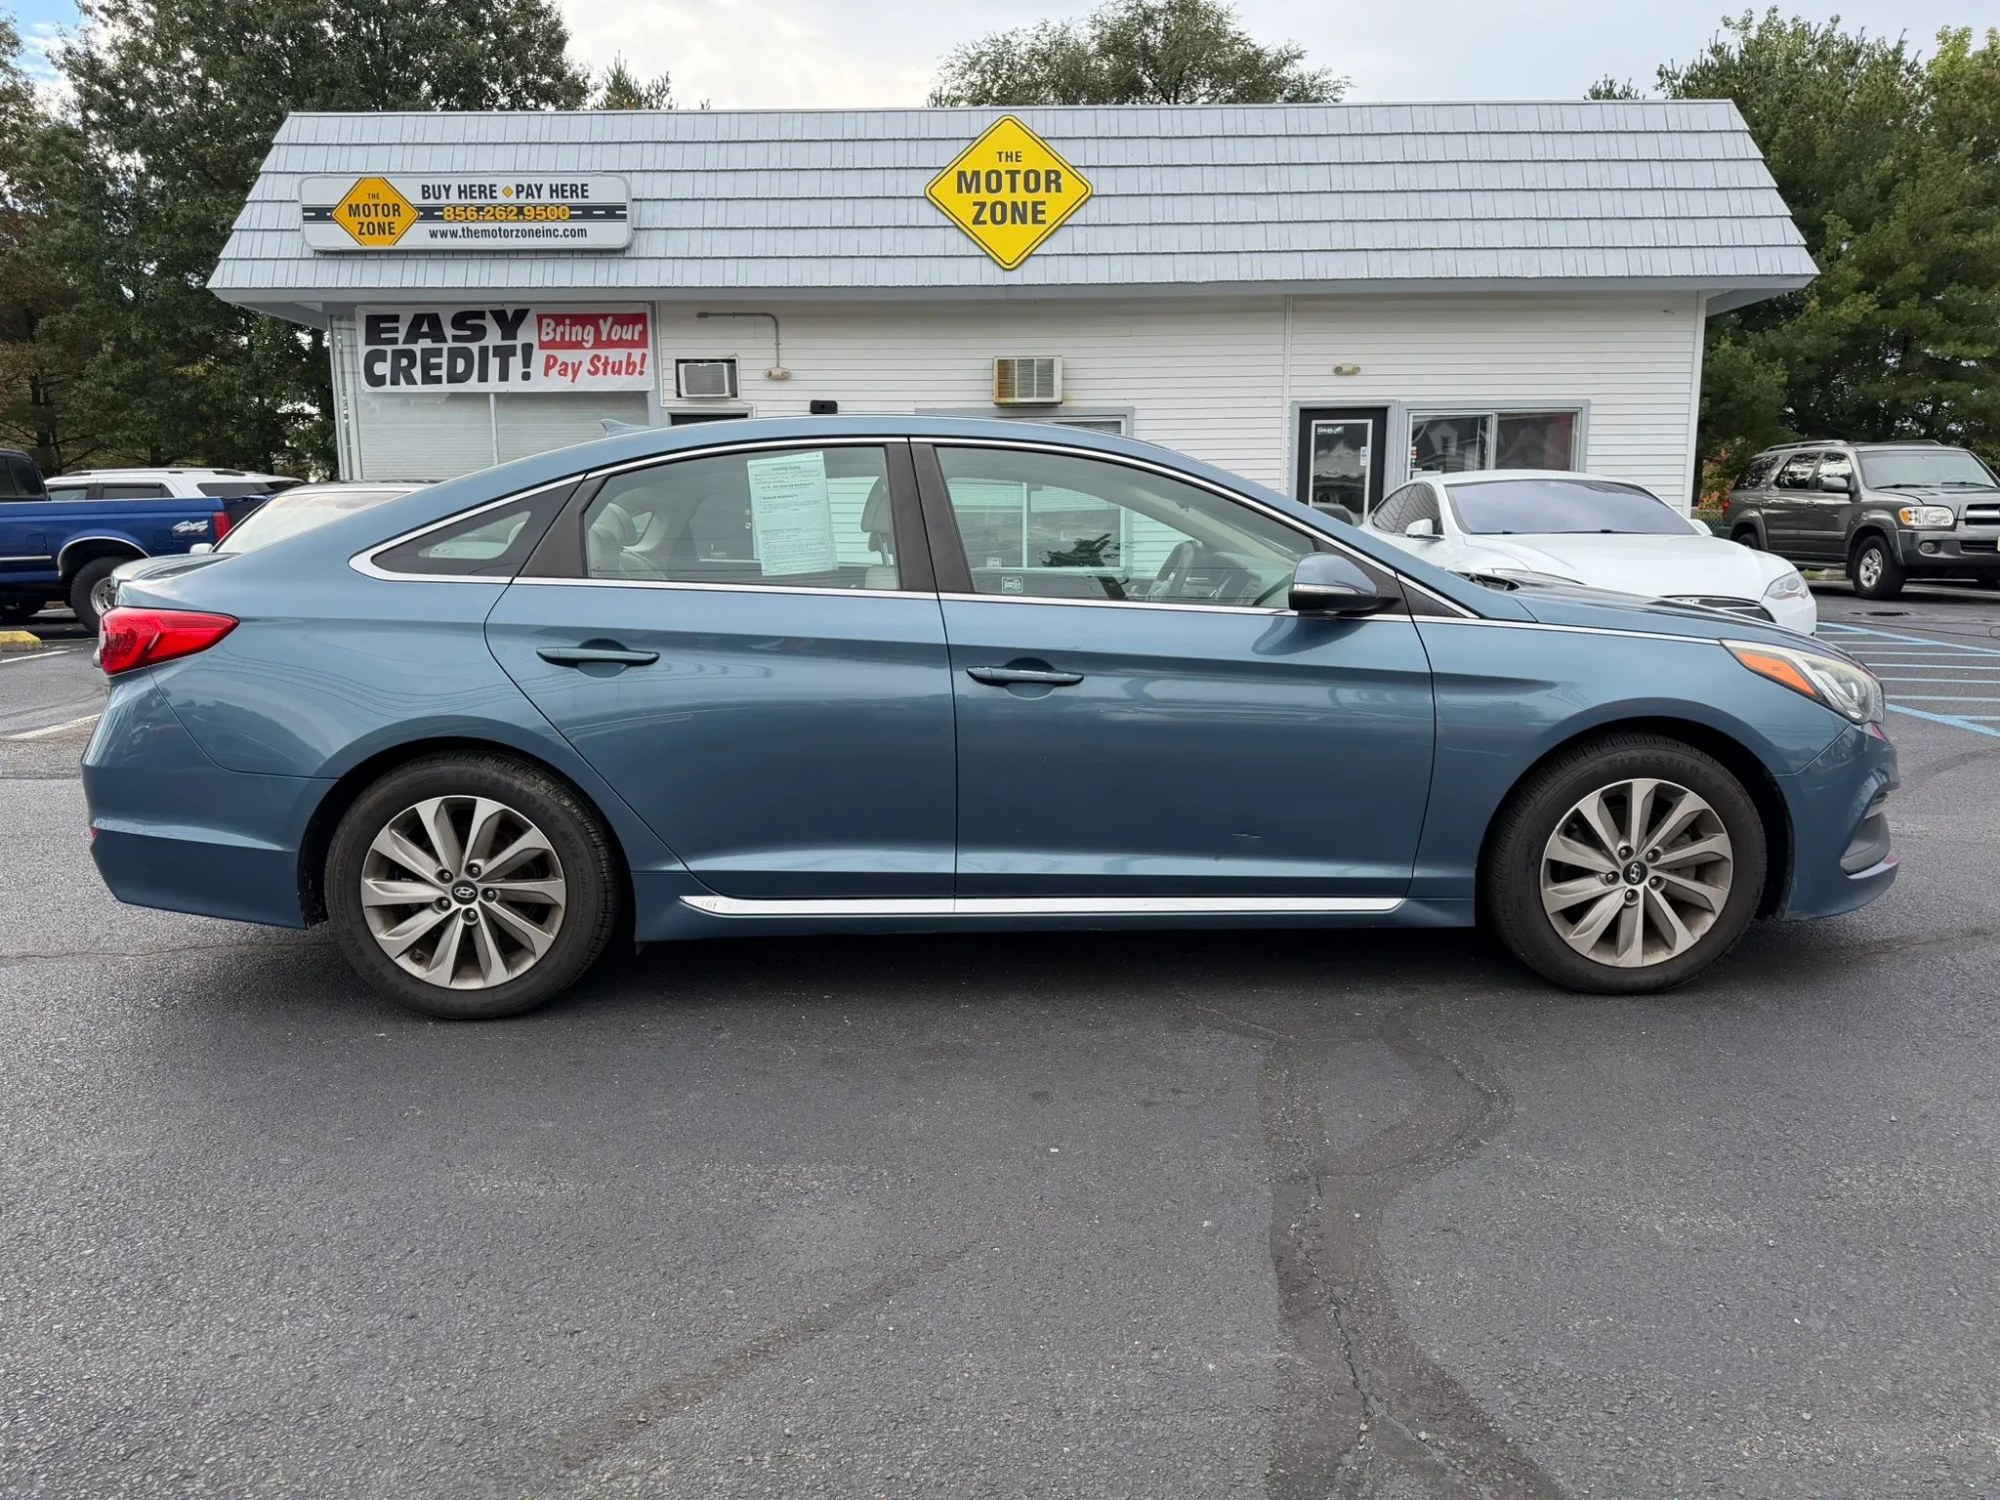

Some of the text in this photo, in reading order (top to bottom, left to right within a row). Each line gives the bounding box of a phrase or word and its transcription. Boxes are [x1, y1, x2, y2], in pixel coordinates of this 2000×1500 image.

[996, 151, 1022, 163] THE
[421, 183, 590, 200] BUY HERE PAY HERE
[956, 169, 1062, 194] MOTOR
[348, 203, 402, 218] MOTOR
[442, 205, 571, 222] 856.262.9500
[972, 200, 1047, 226] ZONE
[357, 221, 396, 236] ZONE
[428, 226, 588, 239] www.themotorzoneinc.com
[365, 309, 531, 345] EASY
[540, 316, 643, 348] Bring Your
[363, 342, 534, 388] CREDIT!
[543, 351, 648, 383] Pay Stub!
